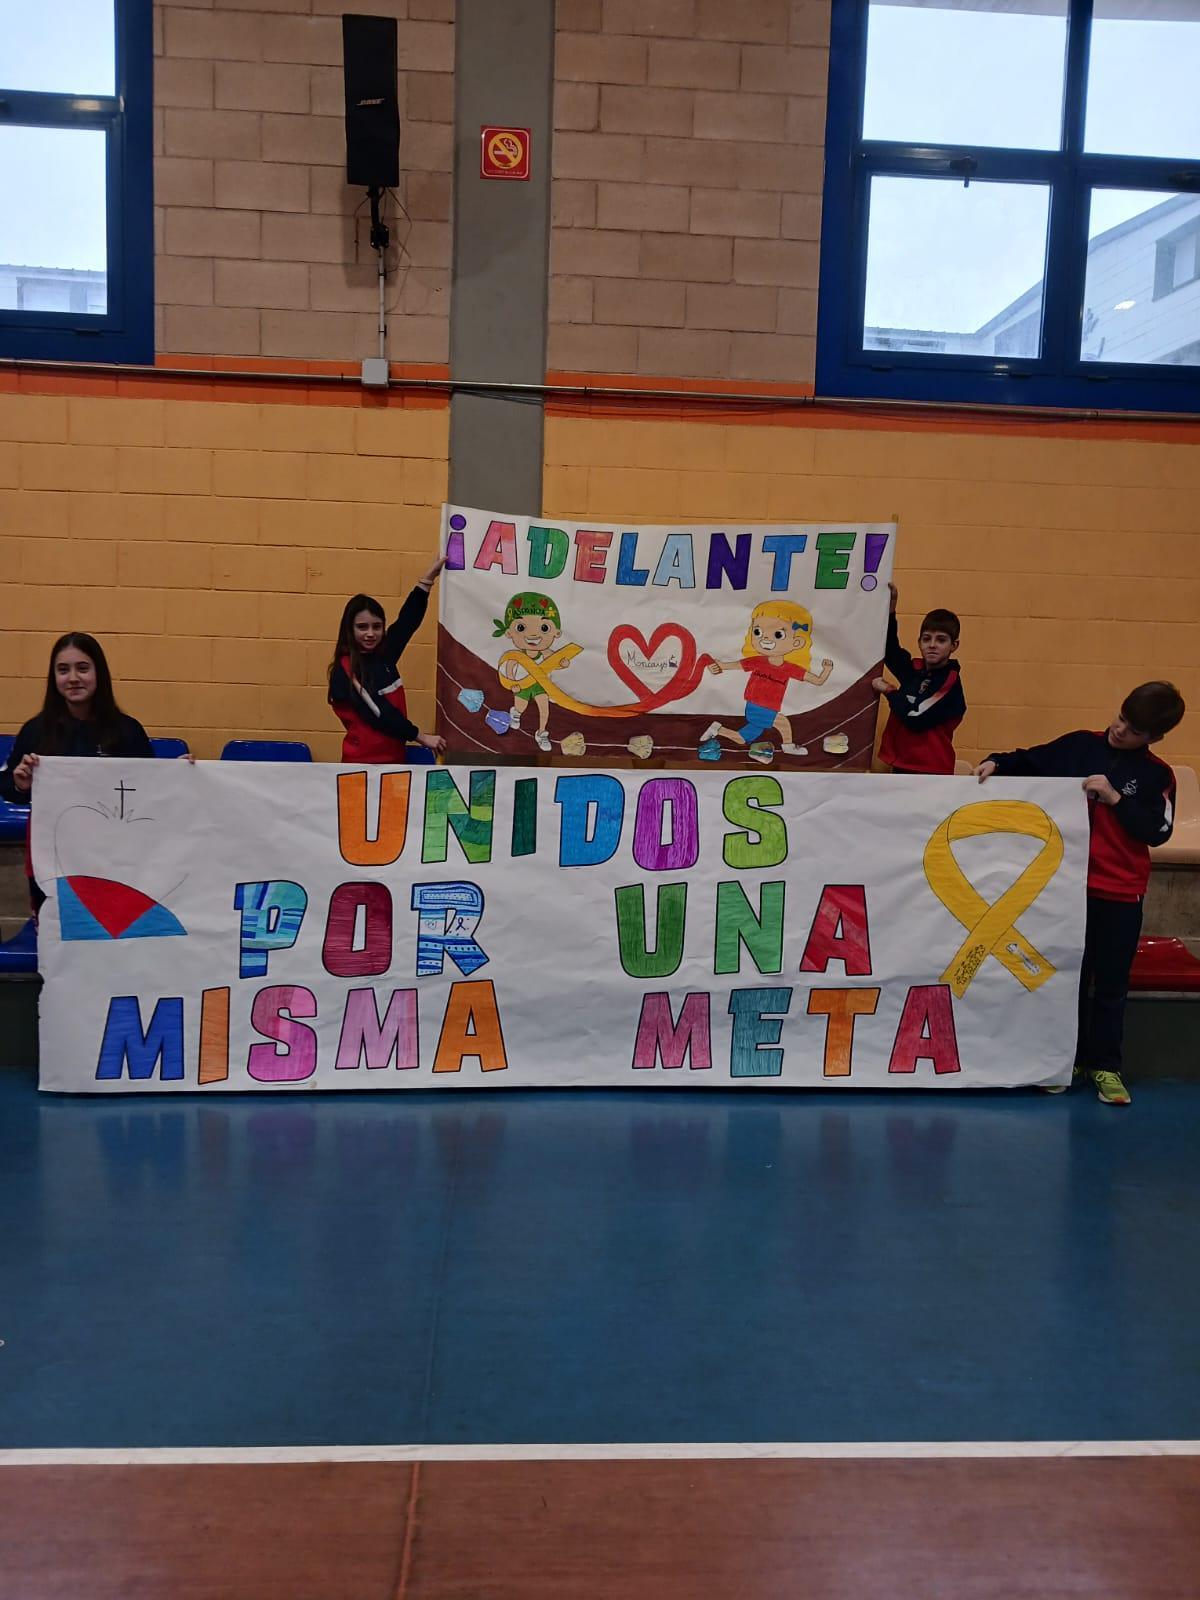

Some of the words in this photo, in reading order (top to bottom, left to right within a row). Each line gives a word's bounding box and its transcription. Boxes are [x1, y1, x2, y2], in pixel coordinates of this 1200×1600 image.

[445, 514, 889, 592] ¡ADELANTE!
[337, 769, 788, 871] UNIDOS
[233, 879, 490, 979] POR
[615, 880, 873, 978] UNA
[95, 979, 508, 1085] MISMA
[631, 984, 962, 1078] META
